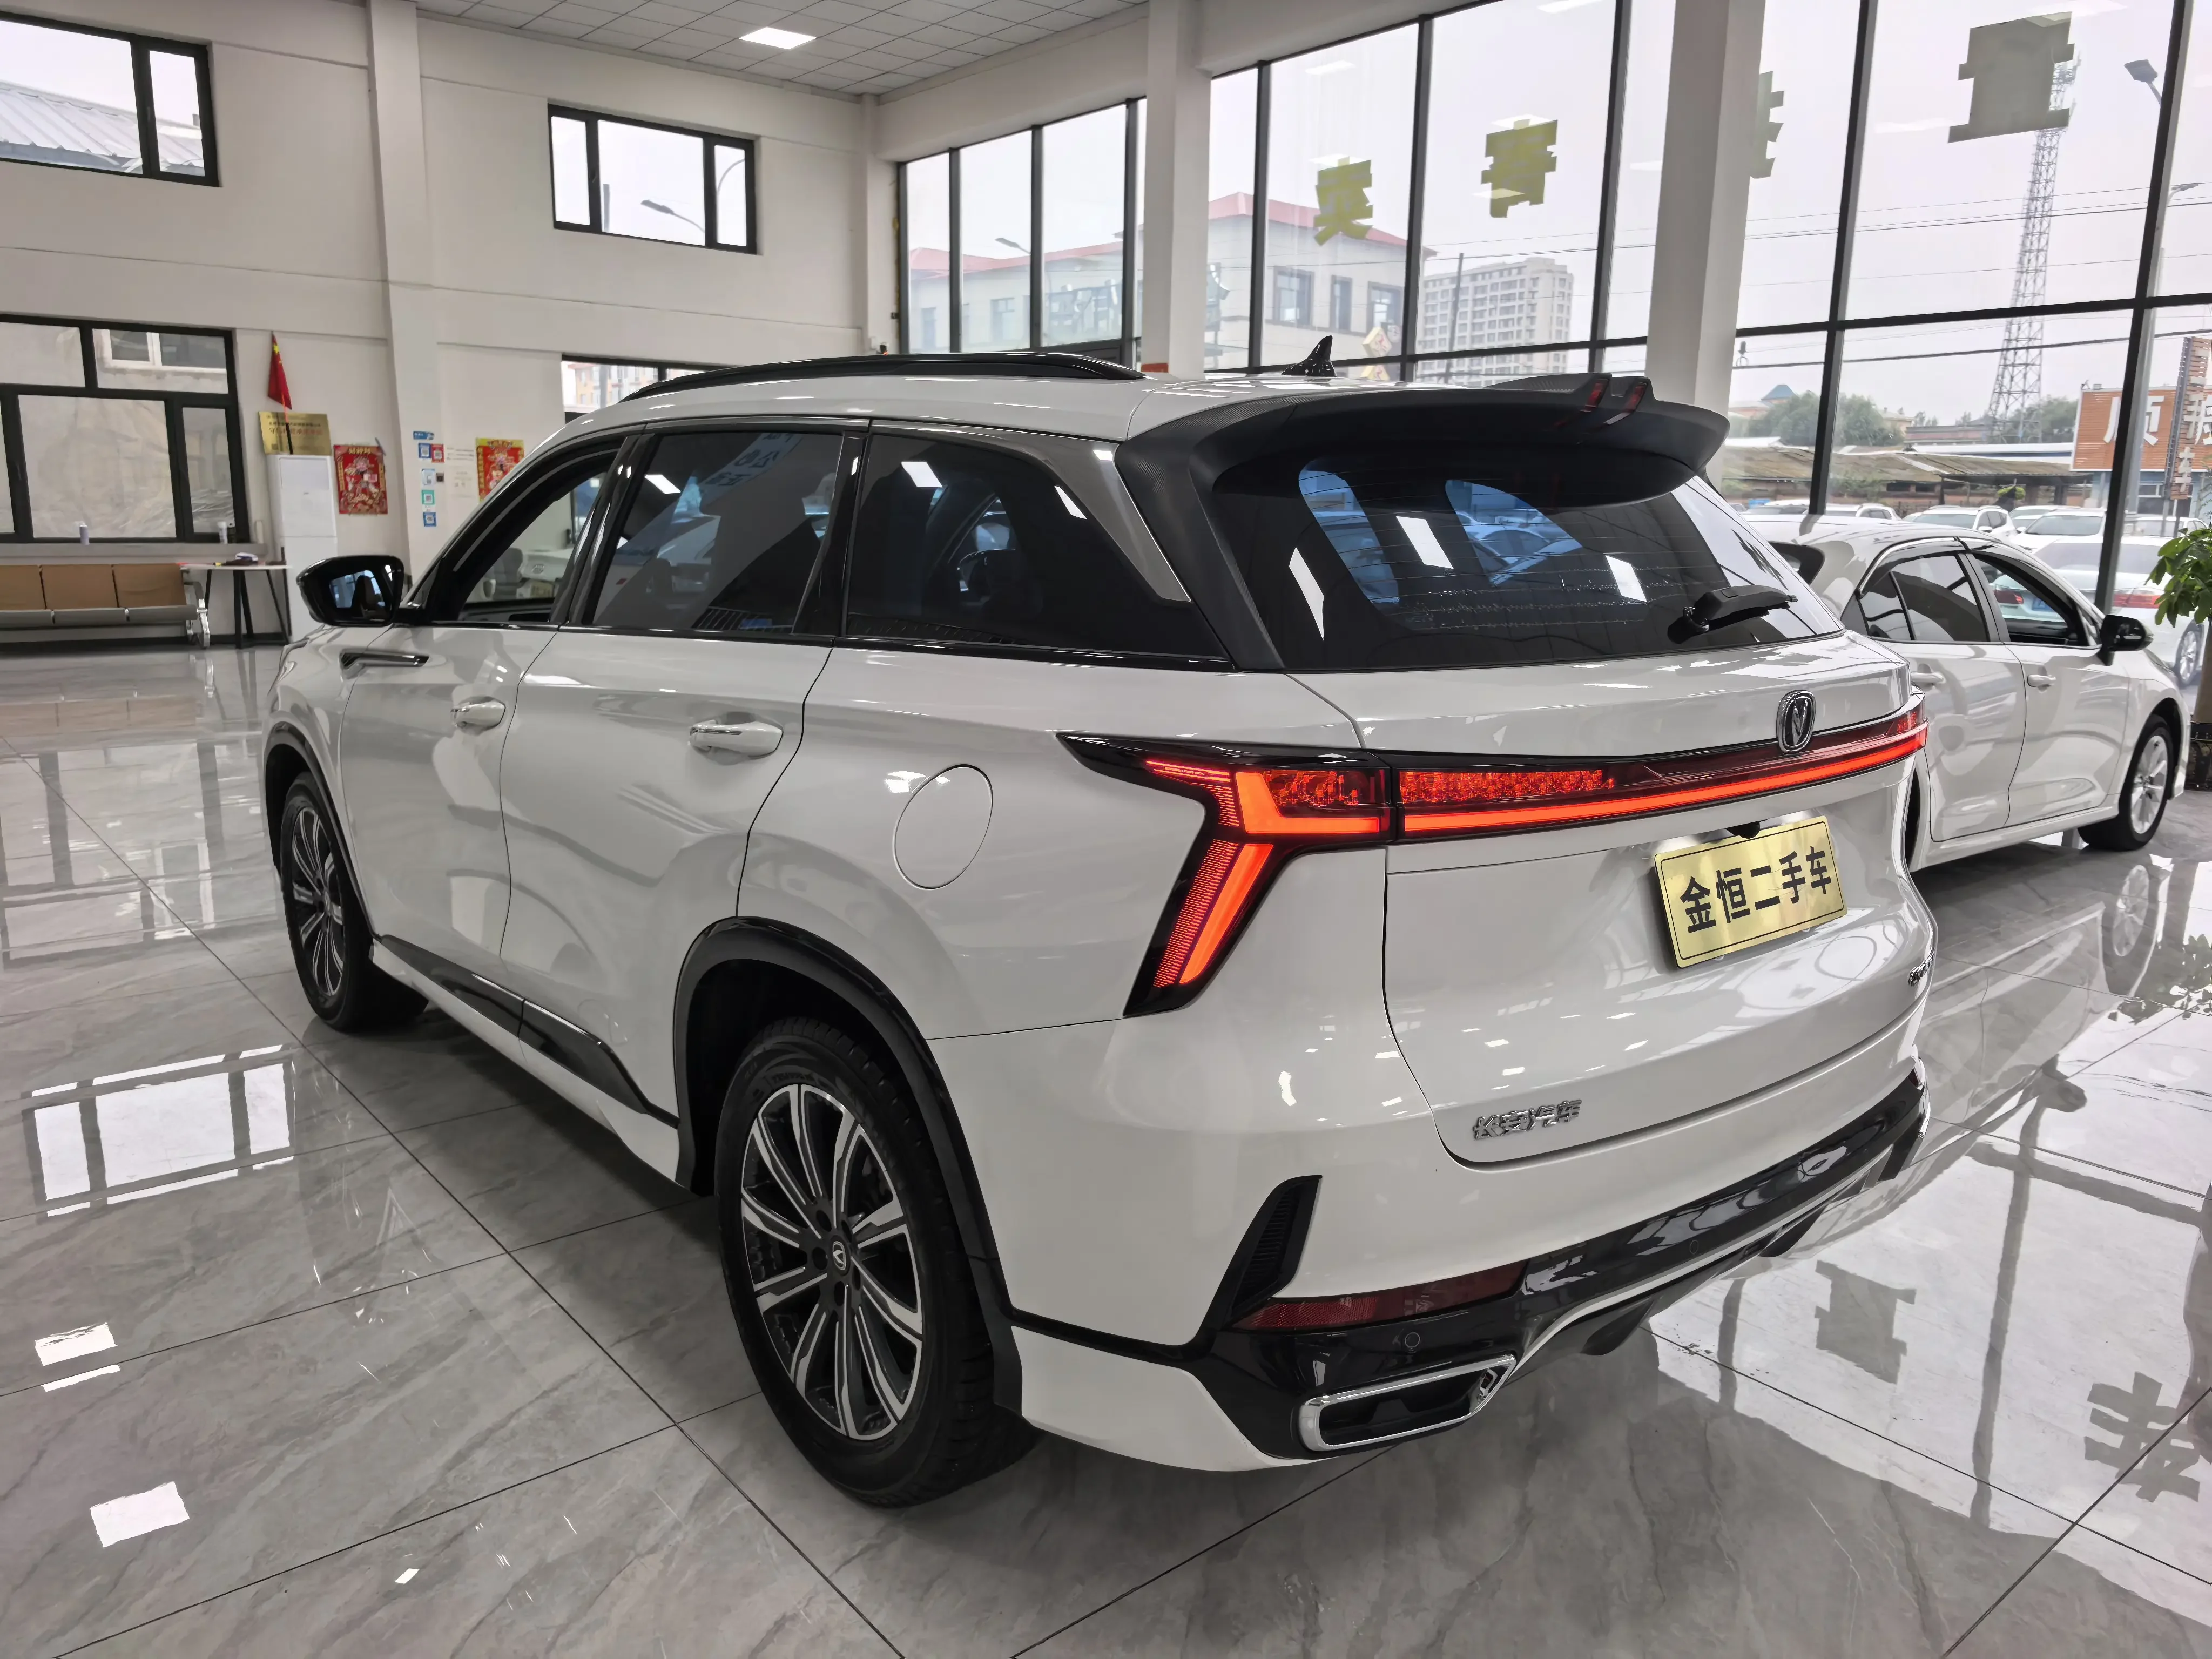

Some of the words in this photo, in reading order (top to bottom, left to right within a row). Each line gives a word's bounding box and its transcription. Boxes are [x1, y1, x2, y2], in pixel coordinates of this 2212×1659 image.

[1680, 846, 1832, 933] 金恒二手车
[1472, 1099, 1582, 1141] 长安汽车
